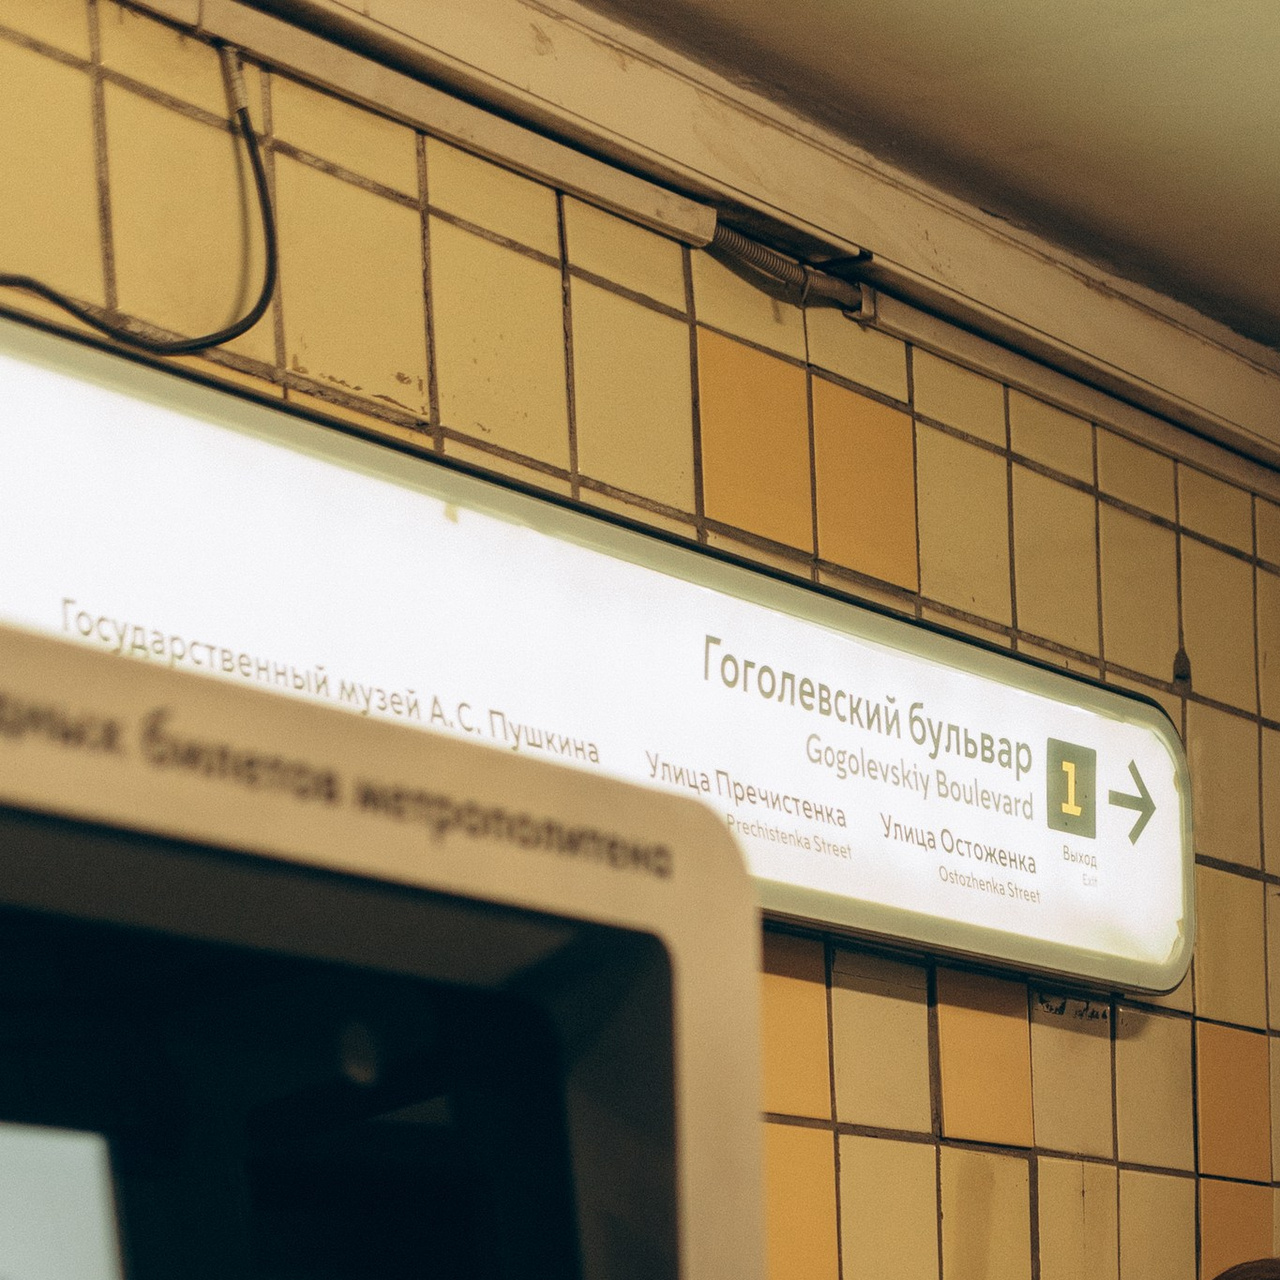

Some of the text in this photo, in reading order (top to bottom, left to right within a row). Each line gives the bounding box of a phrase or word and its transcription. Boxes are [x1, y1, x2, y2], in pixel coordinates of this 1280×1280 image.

[62, 597, 600, 764] Государственный музей А.С. Пушкина
[703, 634, 1032, 781] Гоголевский бульвар
[645, 750, 848, 828] Улица Пречистенка
[806, 733, 1034, 821] Gogolevskiy Boulevard
[1061, 760, 1082, 817] 1
[726, 813, 853, 860] Prechistenka Street
[879, 812, 1037, 874] Улица Остоженка
[1063, 844, 1098, 871] Выход
[938, 865, 1041, 904] Ostozhenka Street
